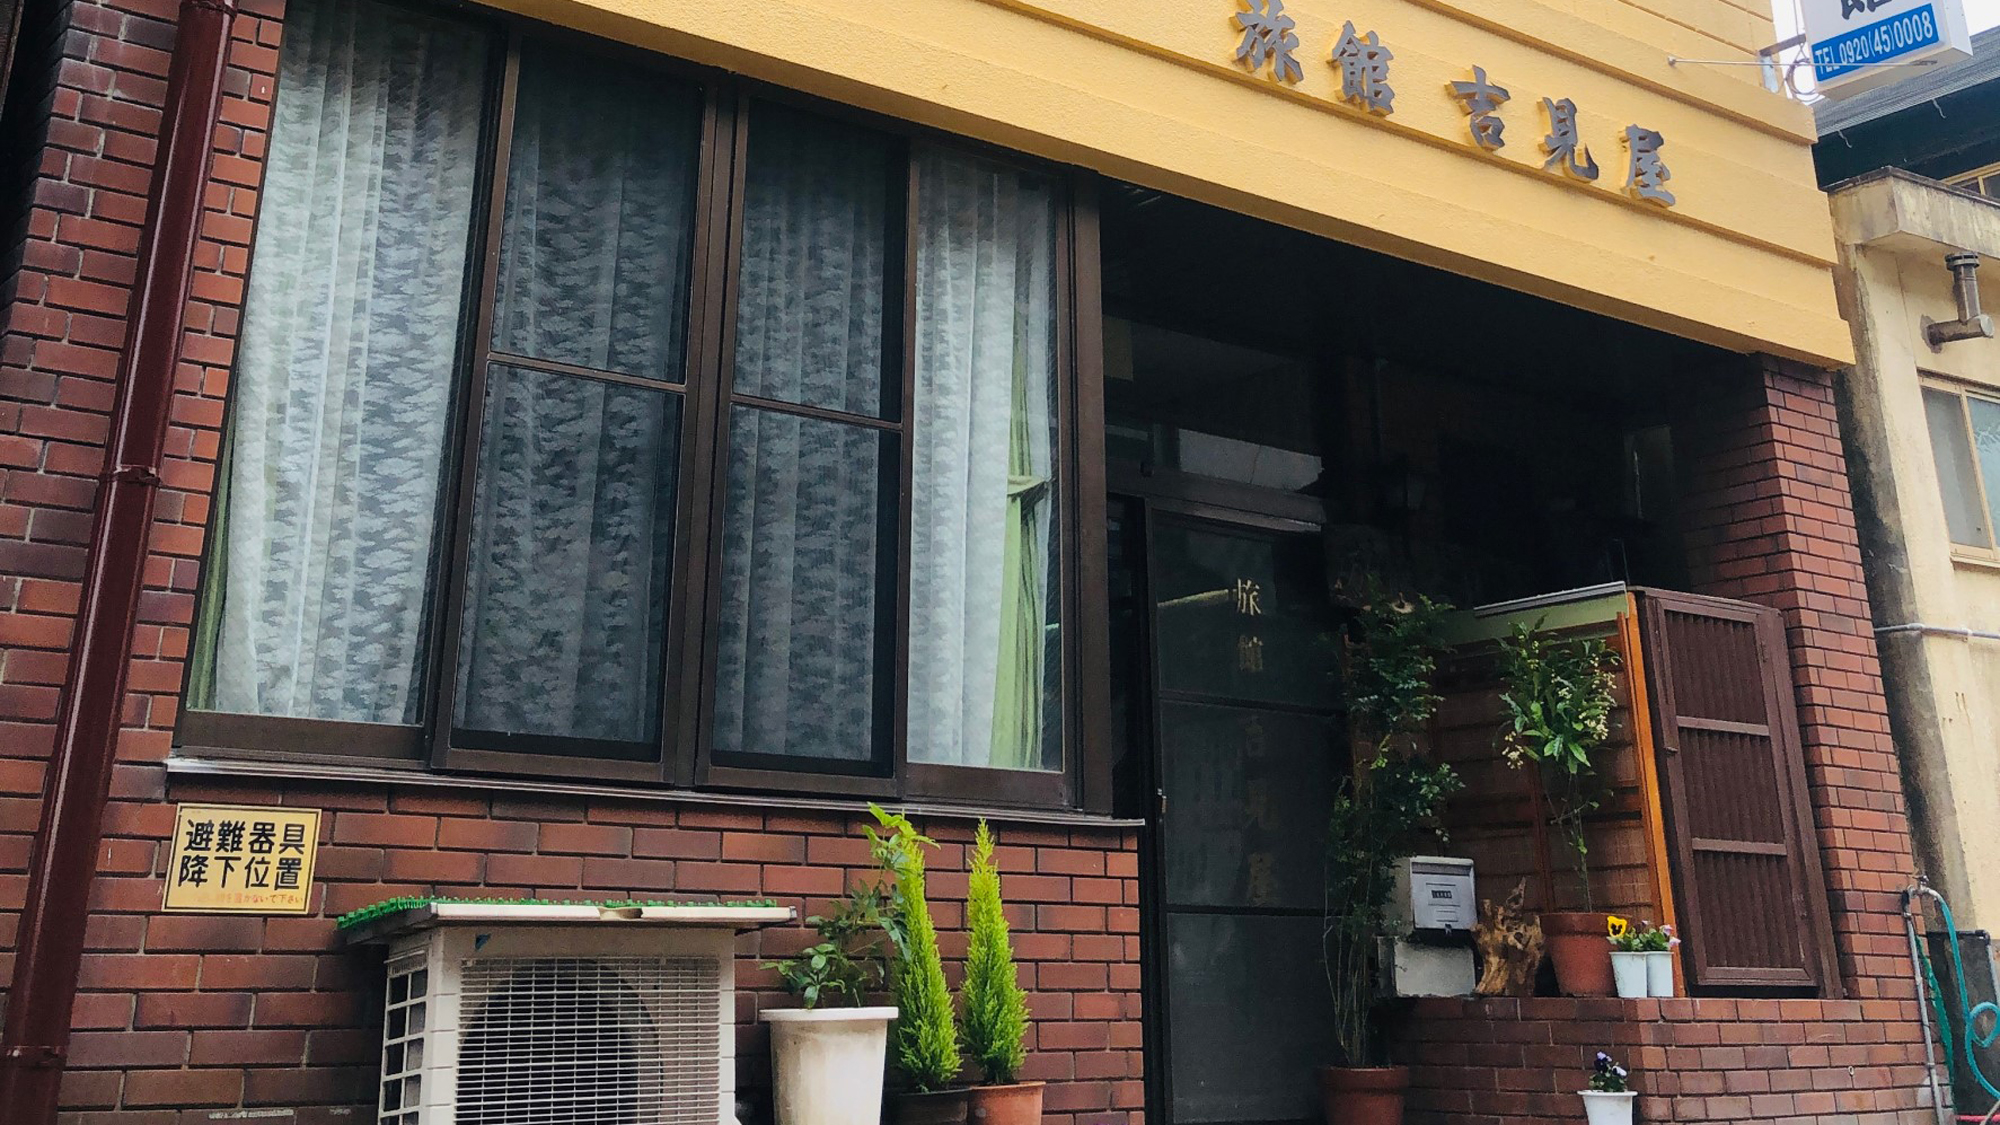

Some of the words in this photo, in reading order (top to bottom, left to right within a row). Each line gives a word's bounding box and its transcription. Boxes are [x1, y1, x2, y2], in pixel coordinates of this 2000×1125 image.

[1815, 46, 1840, 75] TEL
[1839, 11, 1933, 64] 0920(45)0008
[1230, 0, 1395, 116] 旅館
[1444, 65, 1676, 208] 吉見屋
[183, 819, 306, 855] 避難器具
[178, 854, 302, 890] 降下位置
